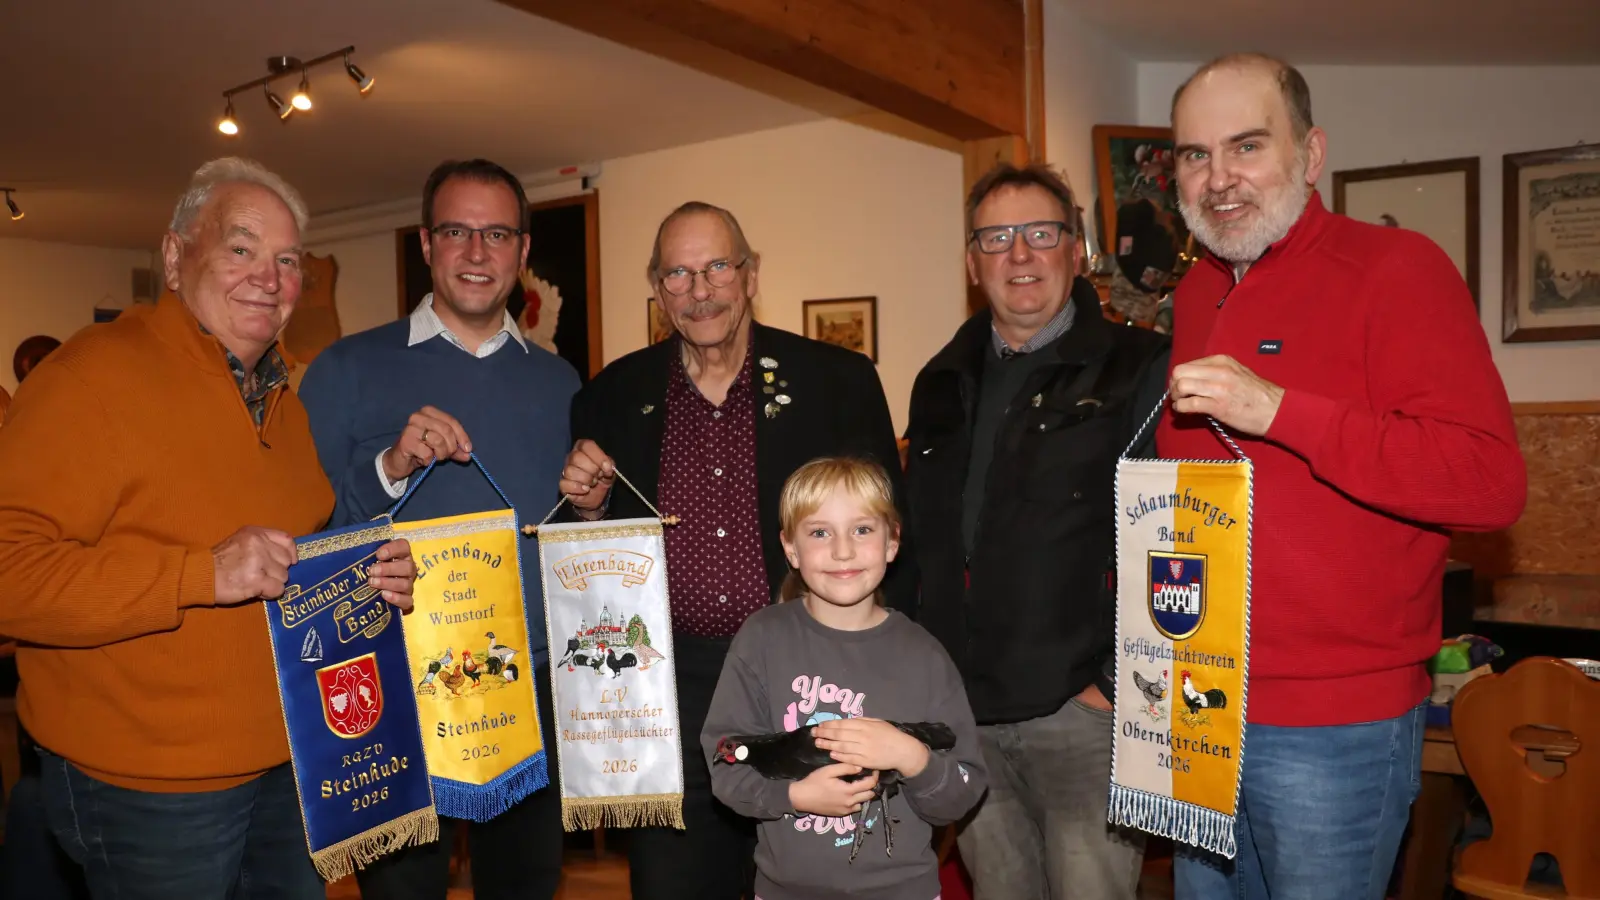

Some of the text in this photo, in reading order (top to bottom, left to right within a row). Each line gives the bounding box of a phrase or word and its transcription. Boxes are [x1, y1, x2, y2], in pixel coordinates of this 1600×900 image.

[1126, 488, 1236, 529] Schaumburger
[1158, 526, 1196, 543] Band
[447, 570, 468, 582] der
[558, 553, 649, 580] Ehrenband
[284, 578, 349, 621] Steinhuder
[443, 588, 477, 603] Stadt
[345, 601, 383, 633] Band
[429, 604, 496, 625] Wunstorf
[1123, 637, 1236, 669] Geflügelzuchtverein
[569, 703, 663, 720] Hannoverscher
[437, 712, 516, 738] Steinhude
[562, 723, 674, 744] Rassegeflügelzüchter
[1122, 720, 1232, 759] Obernkirchen
[461, 743, 500, 761] 2026
[1157, 752, 1192, 774] 2026
[321, 756, 409, 799] Steinhude
[602, 759, 638, 774] 2026
[352, 786, 389, 812] 2026
